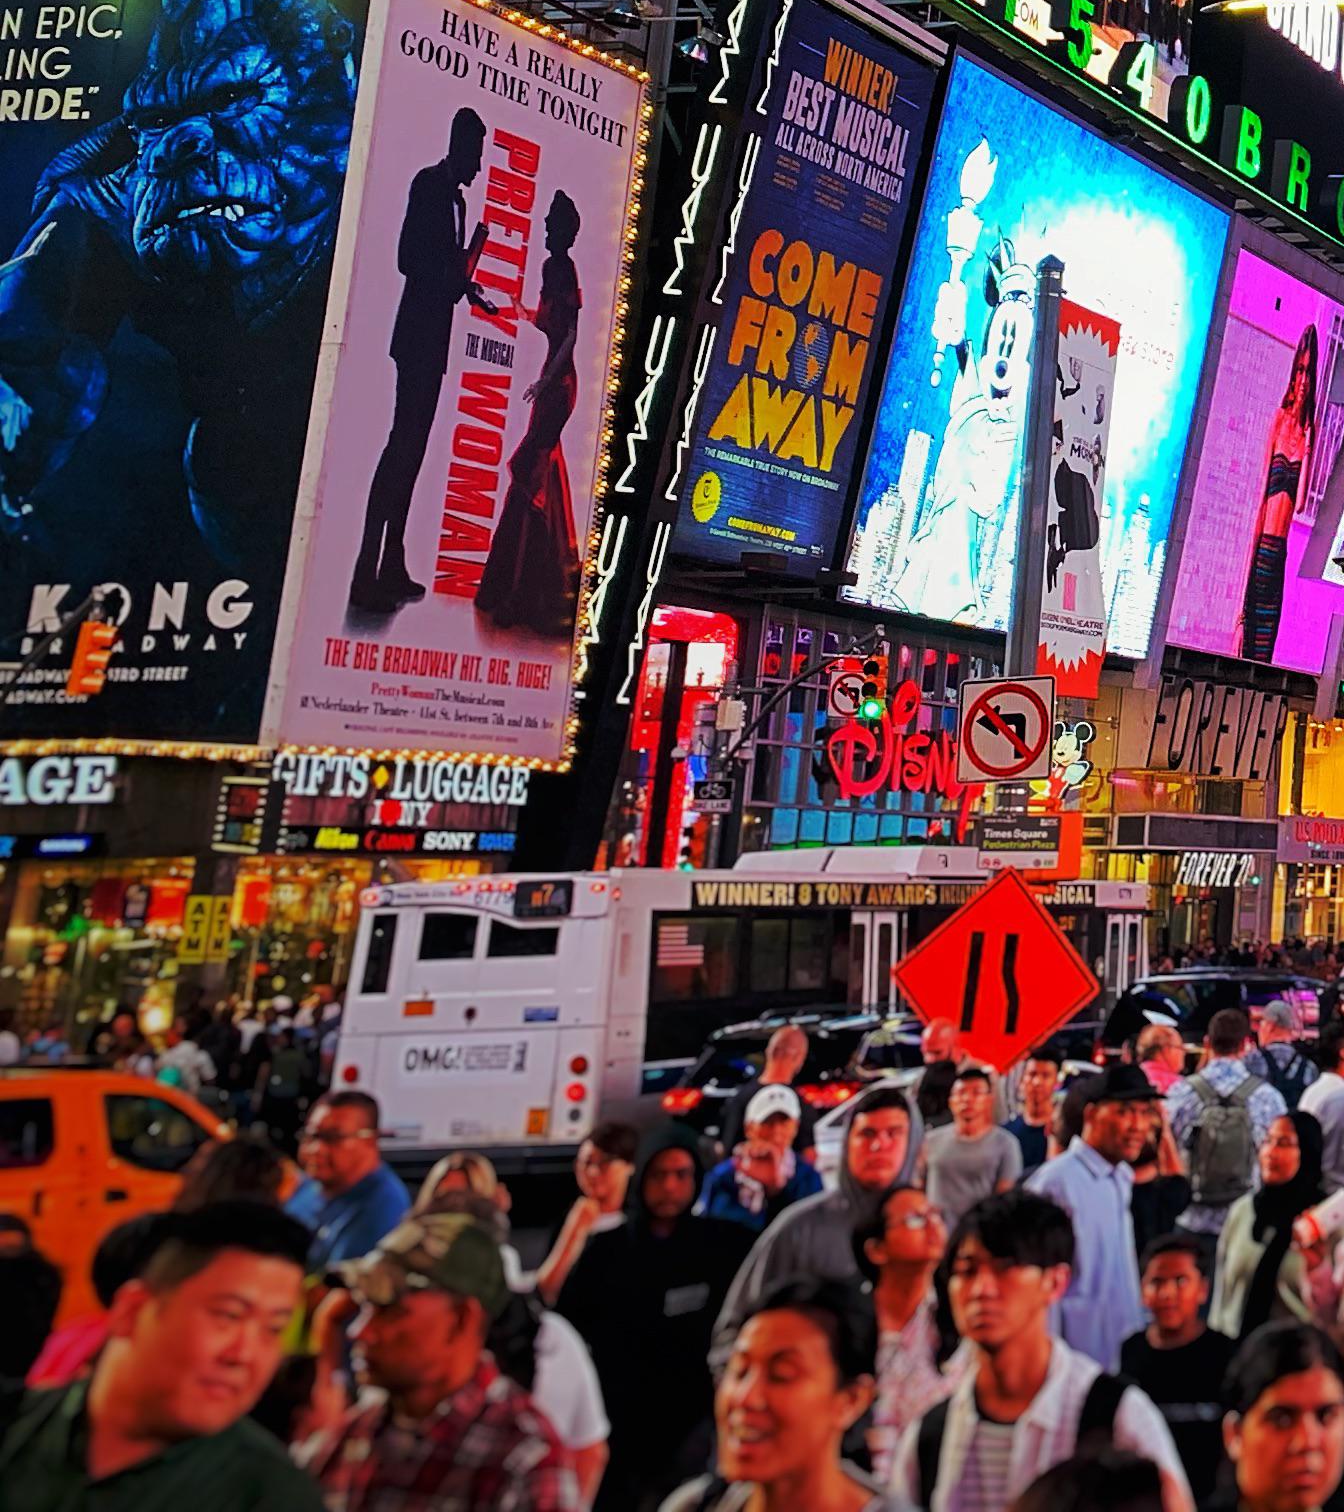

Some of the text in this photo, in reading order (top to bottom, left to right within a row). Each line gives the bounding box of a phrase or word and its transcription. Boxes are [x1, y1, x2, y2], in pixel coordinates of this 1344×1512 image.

[36, 4, 124, 40] EPIC,
[440, 8, 603, 103] HAVE A REALLY
[823, 37, 899, 116] WINNER!
[400, 29, 628, 148] GOOD TIME TONIGHT
[782, 69, 910, 178] BEST MUSICAL
[775, 122, 794, 151] ALL
[797, 131, 835, 170] ACROSS
[834, 153, 864, 187] NORTH
[863, 164, 902, 204] AMERICA
[469, 127, 542, 339] PRETTY
[749, 228, 884, 338] COME
[465, 332, 515, 369] THE MUSICAL
[707, 372, 855, 473] AWAY
[432, 370, 512, 601] WOMAN
[20, 632, 248, 655] BRADWAY
[324, 637, 553, 692] THE BIG BROADWAY HIT. BIG. HUGE!
[142, 666, 189, 681] STREET
[1146, 673, 1289, 781] FOREVER
[272, 753, 530, 807] GIFTS LUGGAGE
[423, 831, 476, 851] SONY
[984, 828, 1049, 840] Times Square
[1312, 823, 1337, 845] POLO
[696, 882, 795, 906] WINNER!
[815, 883, 864, 906] TONY
[866, 883, 938, 906] AWARDS
[1177, 851, 1237, 887] FOREVER
